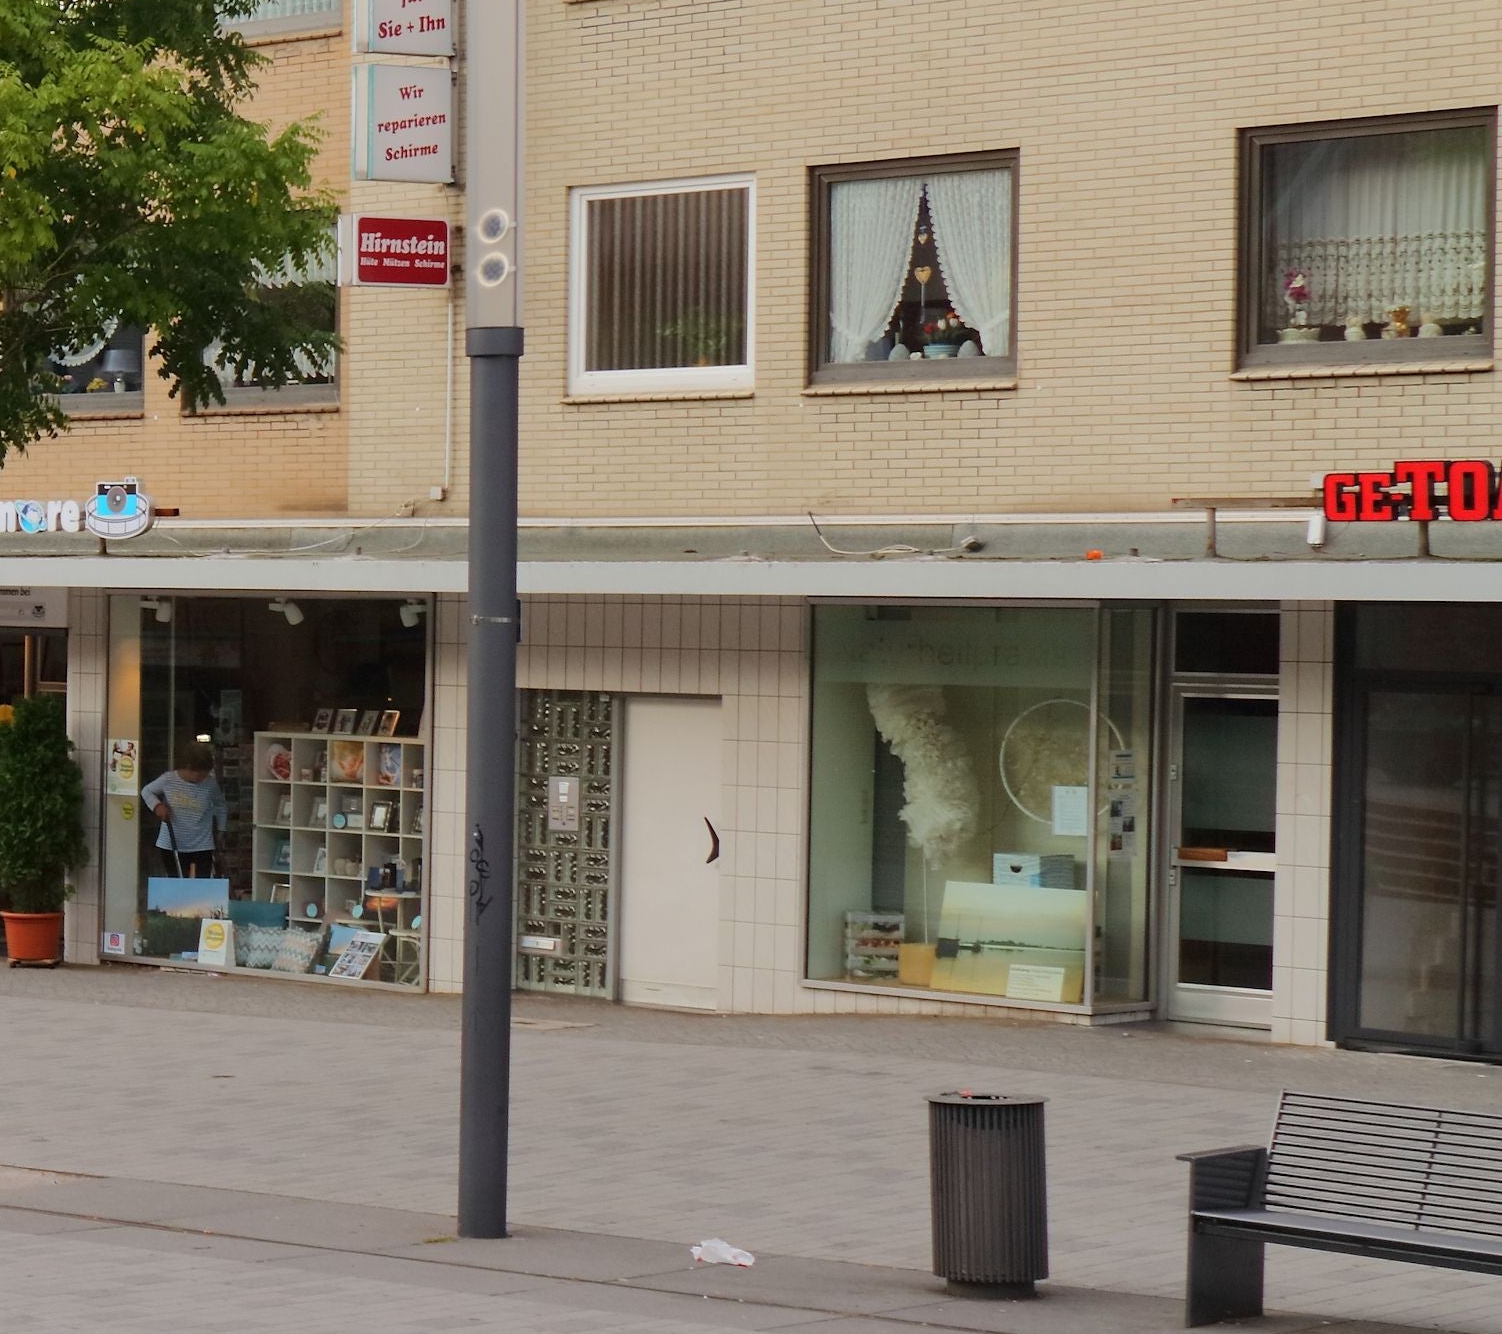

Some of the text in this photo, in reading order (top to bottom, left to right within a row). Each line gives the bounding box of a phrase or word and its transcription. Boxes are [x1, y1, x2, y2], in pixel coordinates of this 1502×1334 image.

[378, 20, 402, 38] Sie
[419, 15, 445, 32] Ihn
[399, 85, 424, 100] Wir
[378, 113, 446, 134] reparieren
[385, 144, 438, 161] Schirme
[360, 232, 445, 255] Hirnstein
[360, 257, 445, 268] Hüte Mützen Schirme
[1324, 461, 1502, 522] GE-TO
